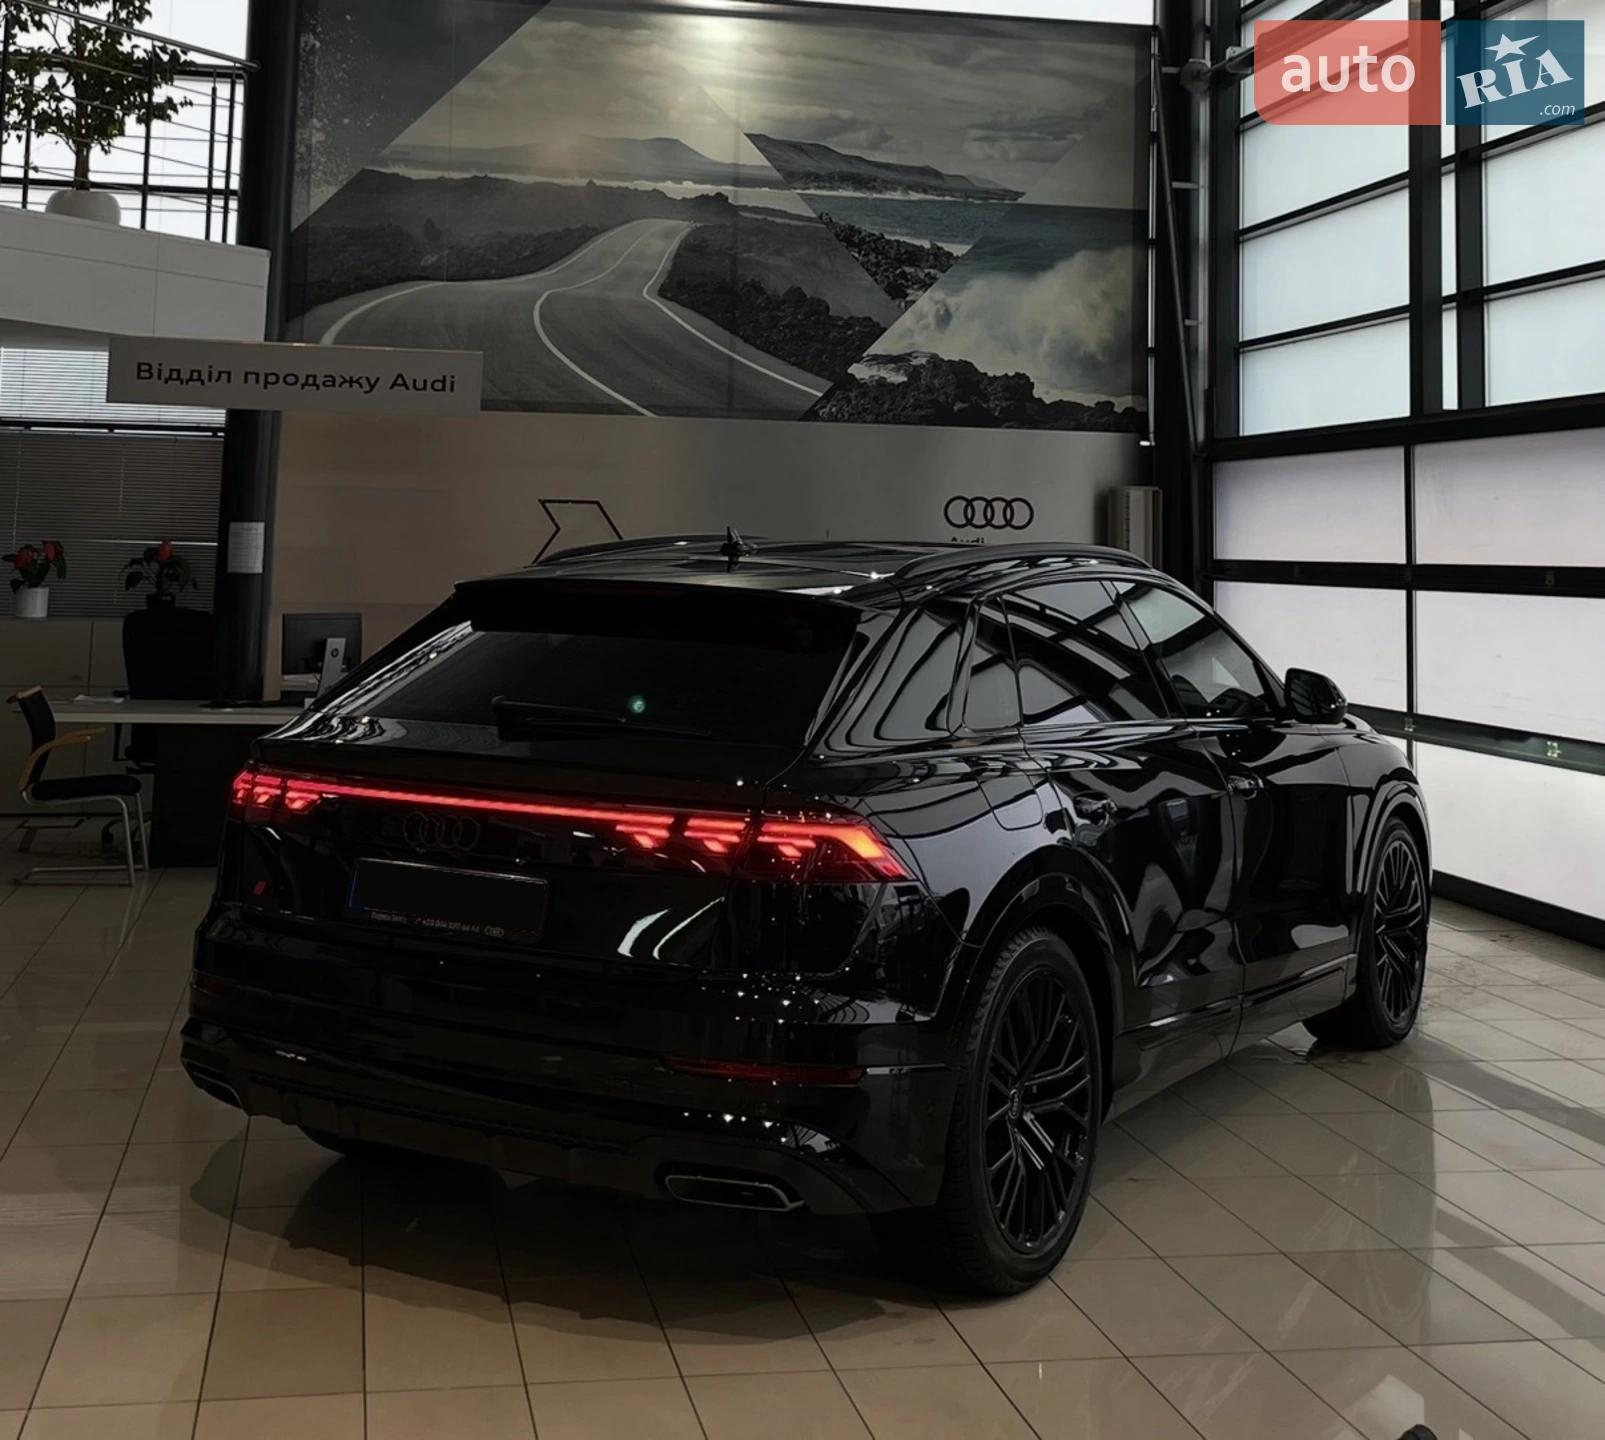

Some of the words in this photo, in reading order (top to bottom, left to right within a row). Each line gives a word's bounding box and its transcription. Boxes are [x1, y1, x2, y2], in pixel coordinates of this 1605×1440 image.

[136, 361, 232, 384] Відділ
[243, 370, 381, 394] продажу
[388, 373, 456, 393] Audi
